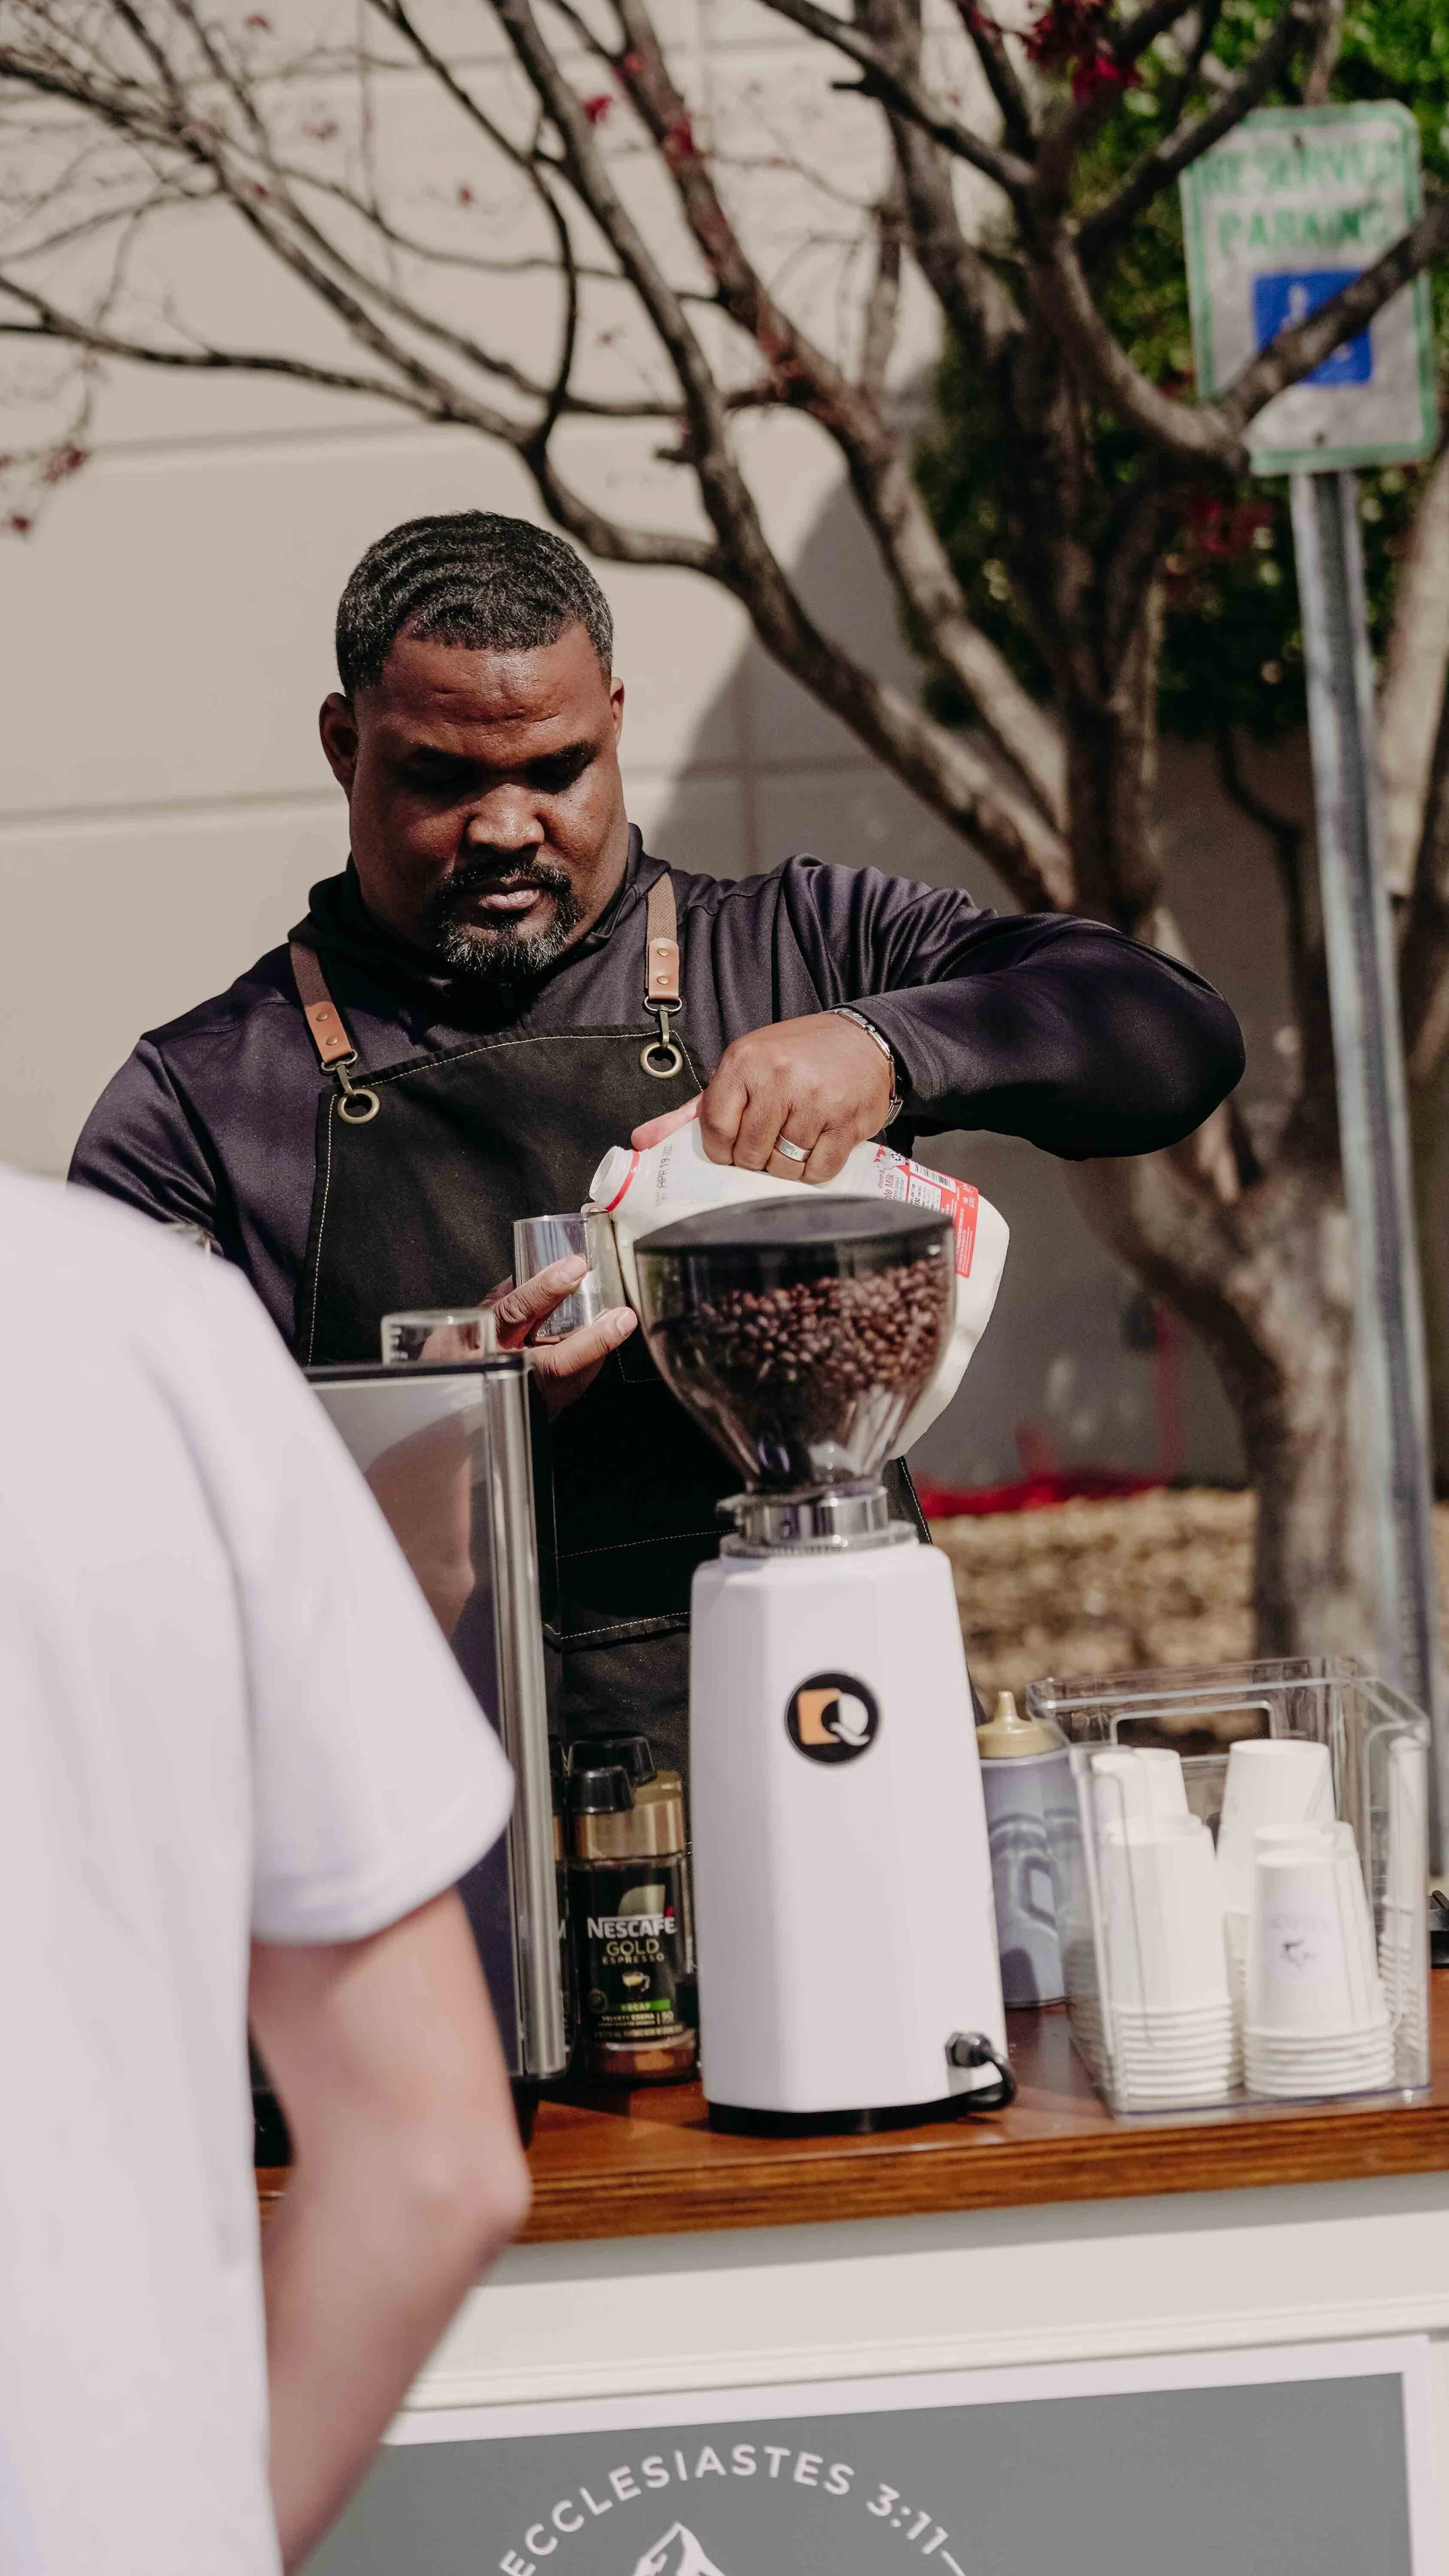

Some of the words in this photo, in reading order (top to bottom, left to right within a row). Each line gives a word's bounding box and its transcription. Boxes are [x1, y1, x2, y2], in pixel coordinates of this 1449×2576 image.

[660, 1158, 670, 1168] 19
[657, 1170, 668, 1189] APR
[885, 1173, 894, 1189] Milk
[884, 1189, 893, 1202] ole
[587, 1906, 675, 1939] NESCAFÉ
[606, 1938, 660, 1957] GOLD
[602, 1951, 665, 1965] ESPRESSO
[500, 2445, 854, 2576] ECCLESIASTES
